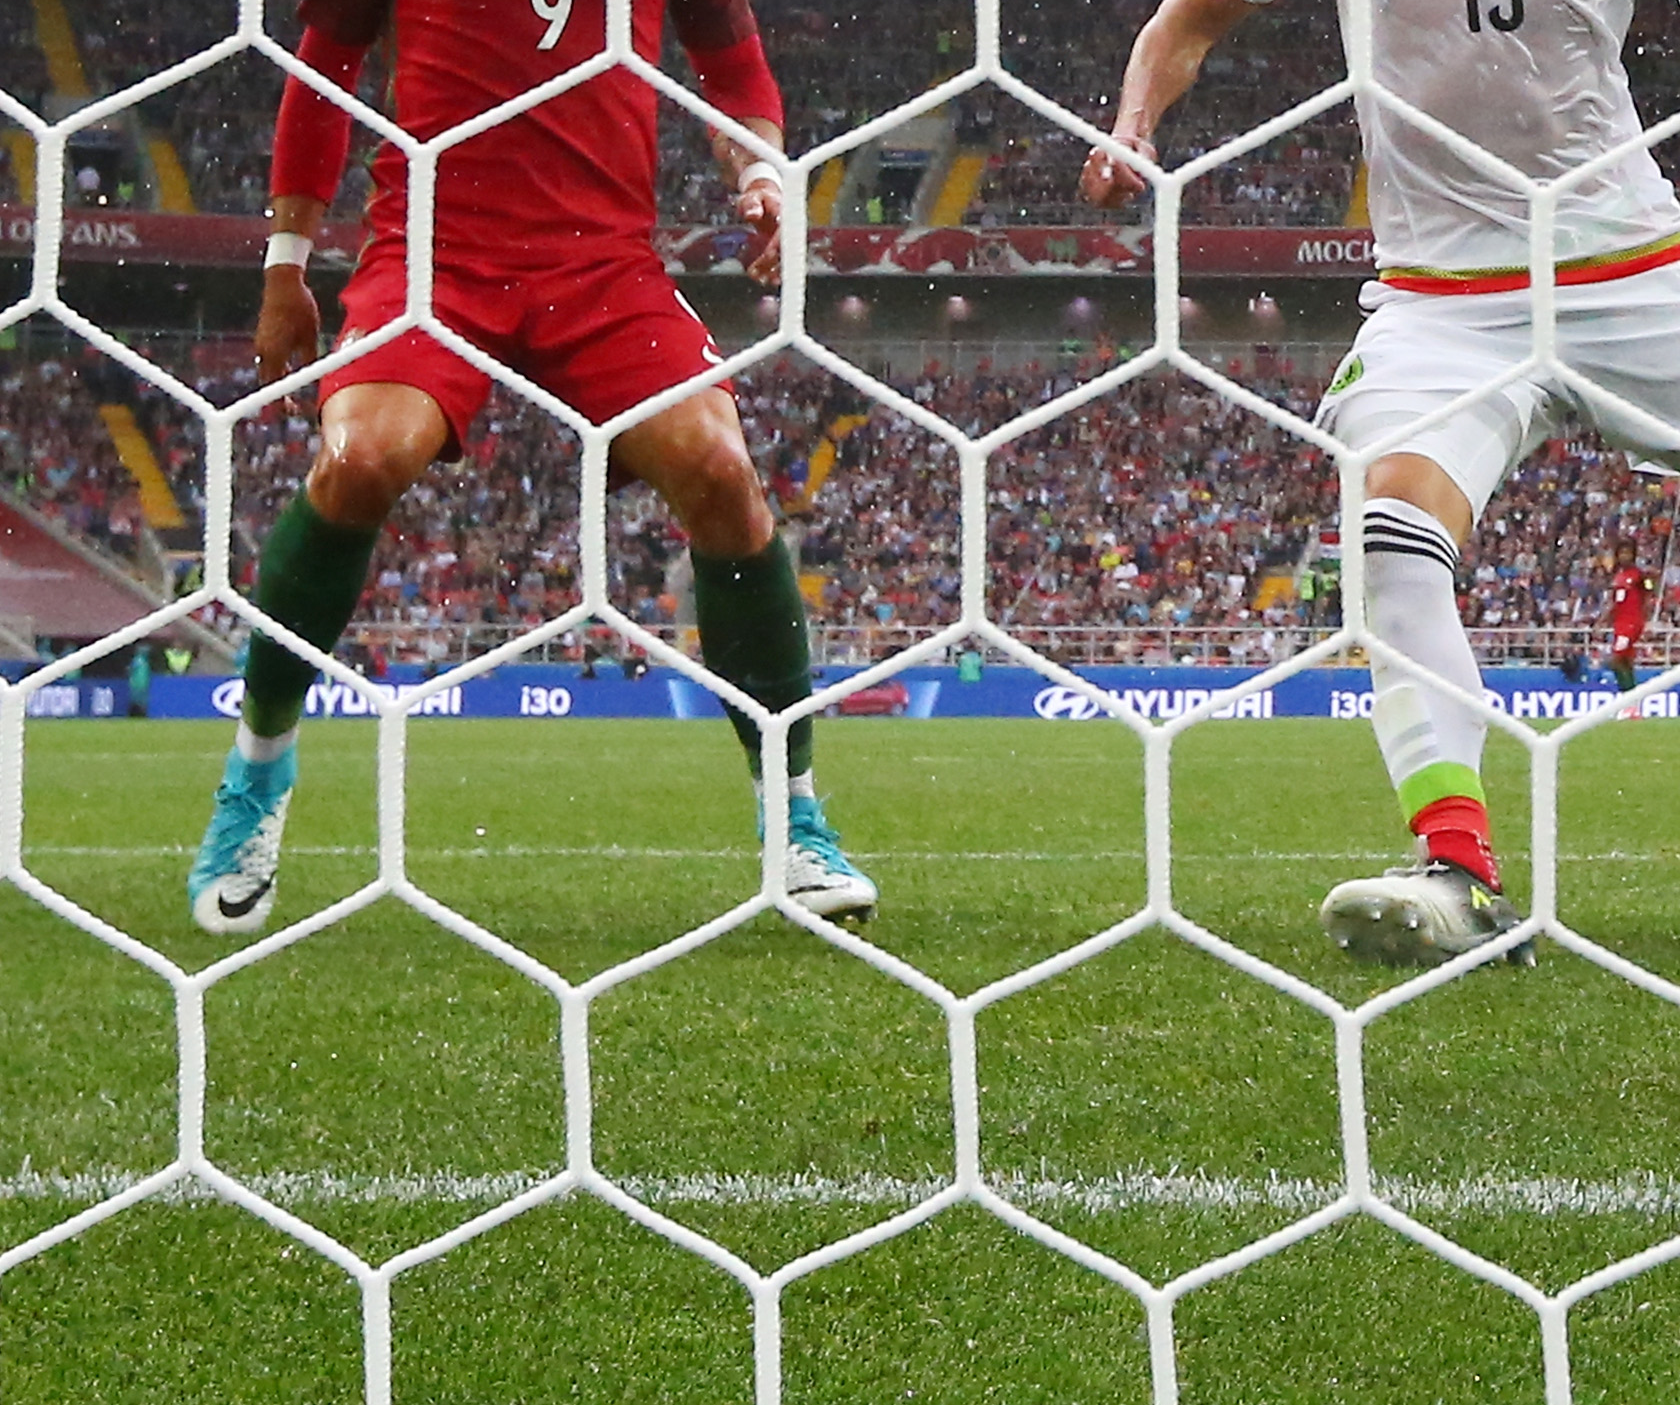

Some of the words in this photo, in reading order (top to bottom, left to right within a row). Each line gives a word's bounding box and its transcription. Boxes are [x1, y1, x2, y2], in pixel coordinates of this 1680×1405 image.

[64, 220, 140, 247] ANS
[521, 685, 572, 716] i30
[1330, 690, 1376, 719] i30
[1513, 691, 1679, 718] HYUNAI
